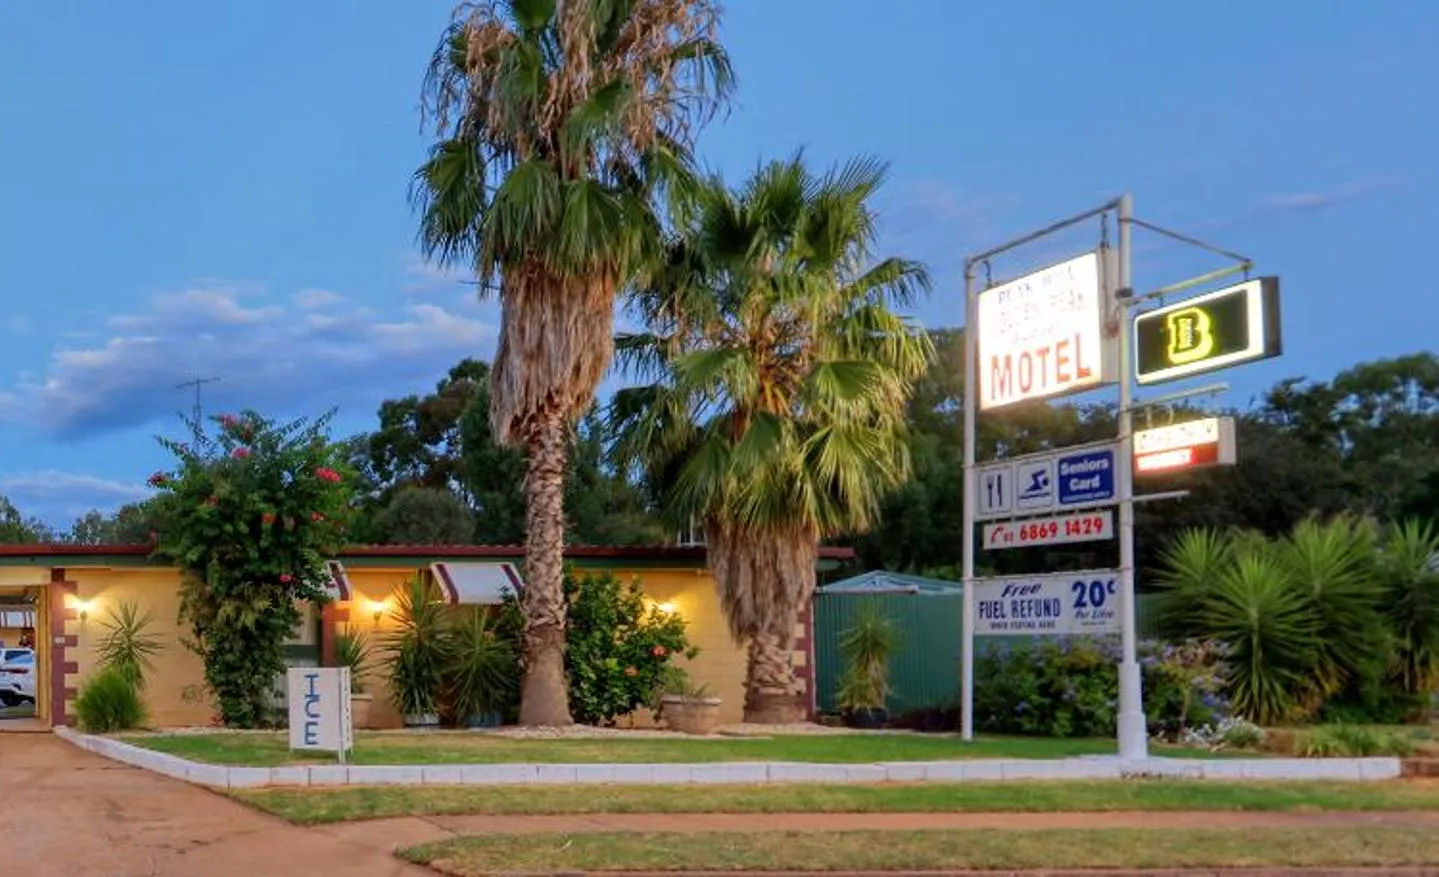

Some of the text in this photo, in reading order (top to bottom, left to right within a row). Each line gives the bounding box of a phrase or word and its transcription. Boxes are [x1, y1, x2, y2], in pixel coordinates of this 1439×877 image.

[990, 333, 1092, 400] MOTEL
[1061, 458, 1109, 475] Seniors
[1070, 475, 1101, 491] Card
[1020, 521, 1058, 541] 6869
[1065, 516, 1103, 536] 1429
[1000, 582, 1043, 598] Free
[979, 598, 1061, 619] FUEL REFUND
[304, 673, 321, 746] ICE
